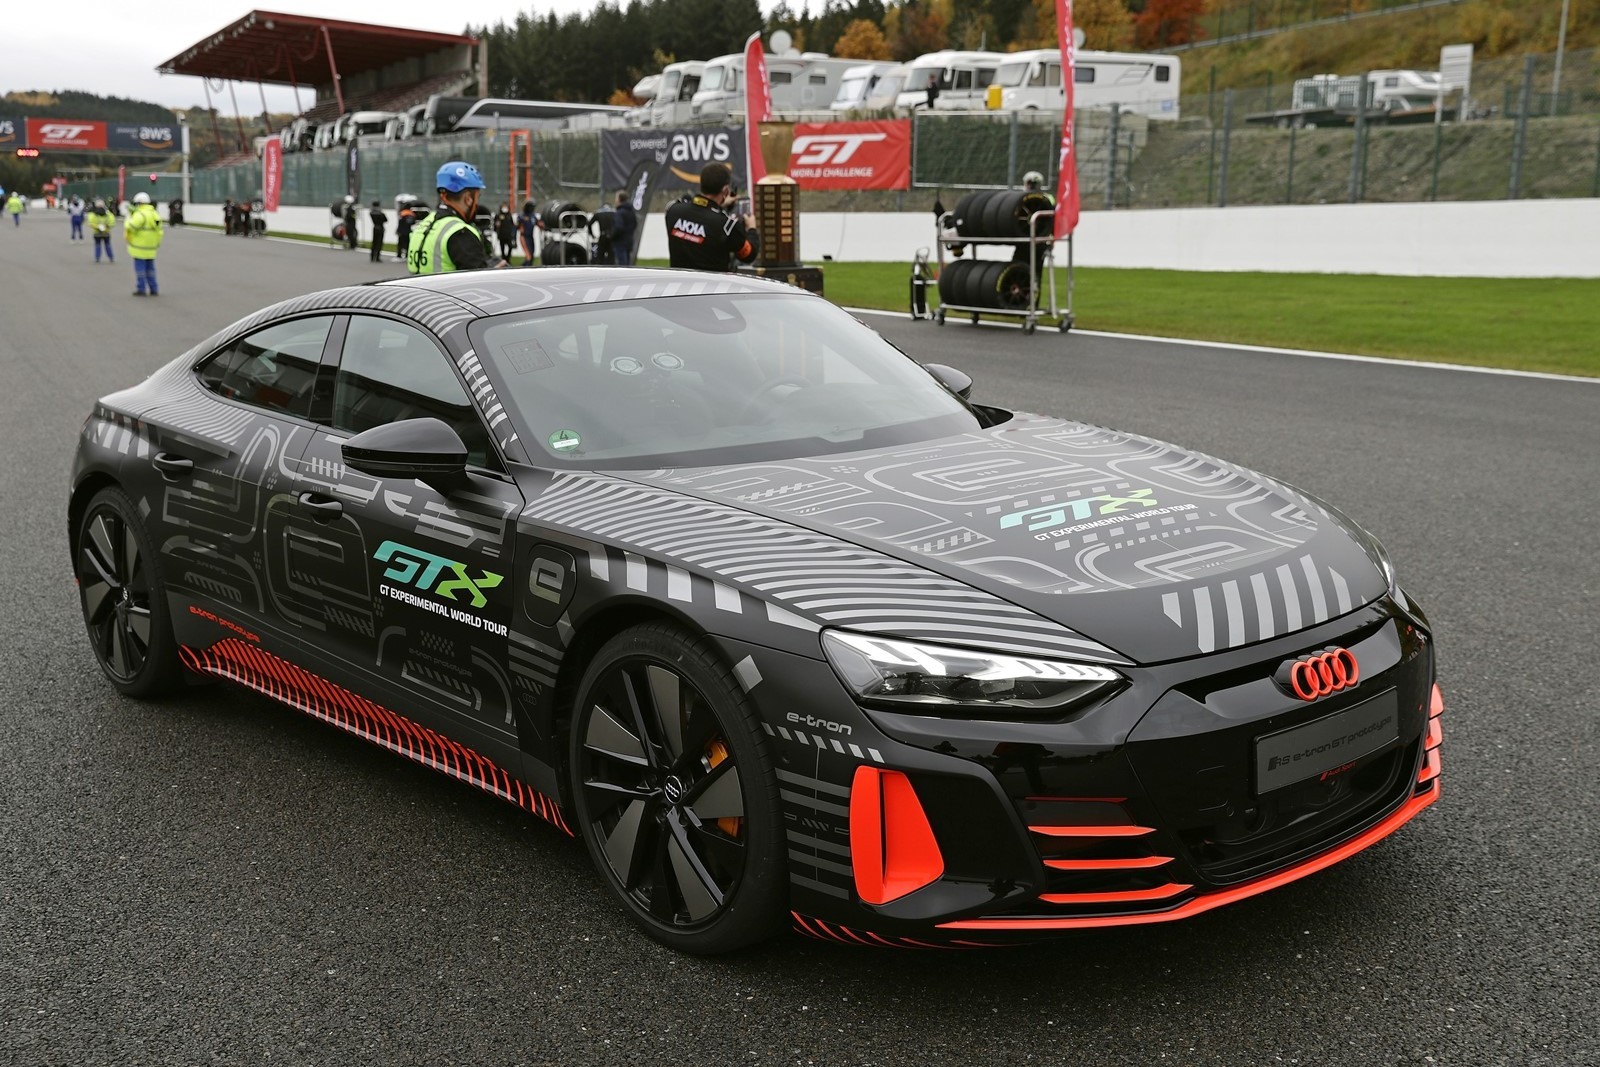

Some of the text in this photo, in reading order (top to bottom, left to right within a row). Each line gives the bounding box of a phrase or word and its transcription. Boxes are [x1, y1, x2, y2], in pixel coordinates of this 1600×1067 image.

[40, 124, 94, 139] GT
[139, 126, 172, 140] aws
[630, 133, 730, 162] powered aws
[655, 150, 668, 165] by
[791, 133, 887, 165] GT
[790, 167, 874, 178] WORLD CHALLENGE
[1034, 503, 1198, 542] GT EXPERIMENTAL WORLD TOUR
[380, 584, 507, 637] GT EXPERIMENTAL WORLD TOUR
[786, 711, 852, 735] e-tron
[1293, 744, 1331, 762] e-tron
[1332, 736, 1347, 749] GT
[1348, 716, 1392, 745] prototype
